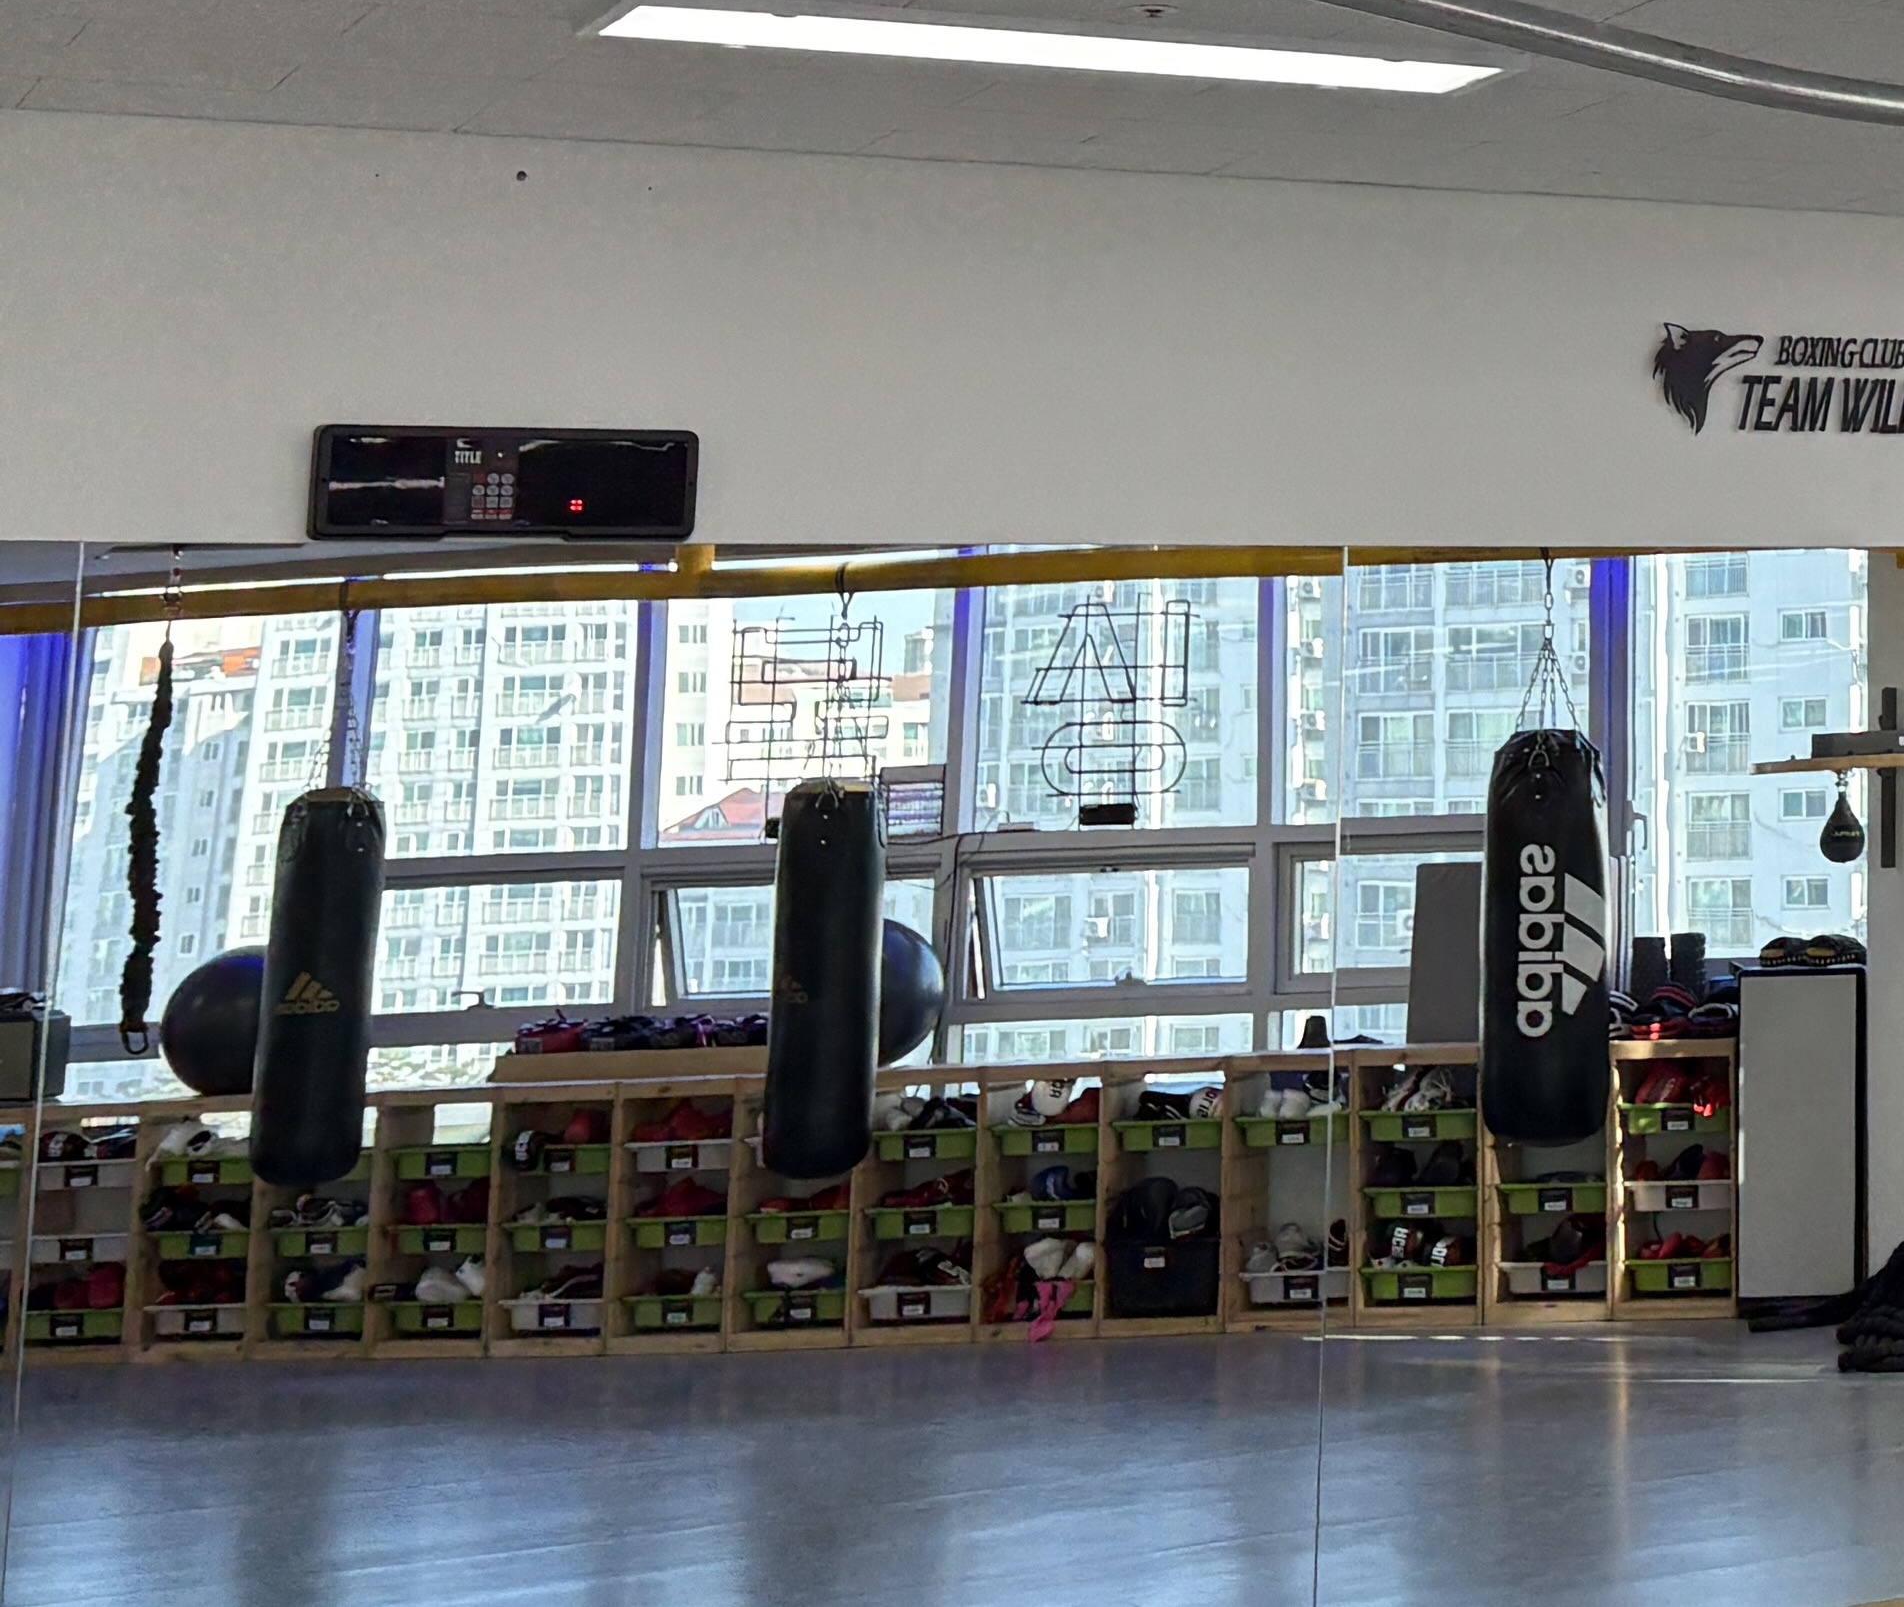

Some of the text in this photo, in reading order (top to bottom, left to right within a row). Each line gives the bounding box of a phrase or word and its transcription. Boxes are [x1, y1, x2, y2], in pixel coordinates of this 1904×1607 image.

[1774, 335, 1858, 369] BOXING
[1738, 374, 1836, 433] TEAM
[454, 449, 483, 465] TITLE
